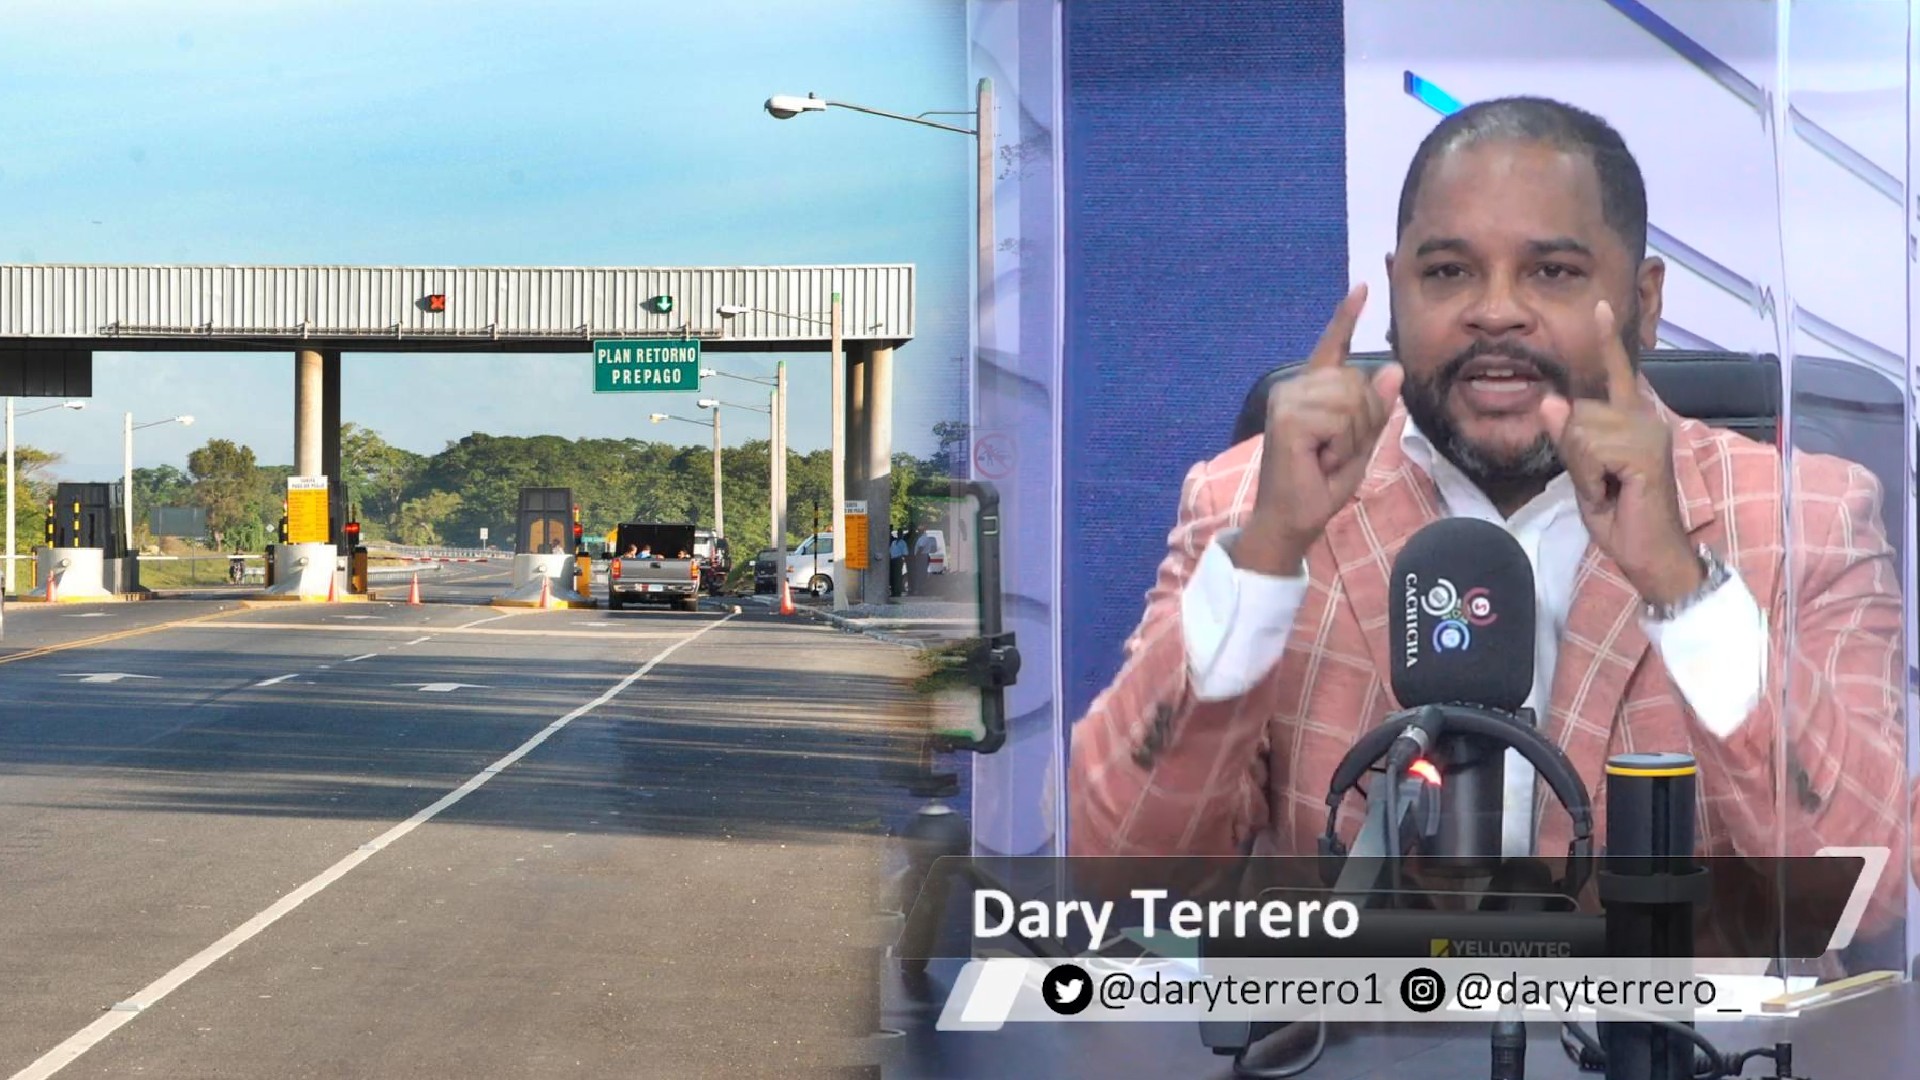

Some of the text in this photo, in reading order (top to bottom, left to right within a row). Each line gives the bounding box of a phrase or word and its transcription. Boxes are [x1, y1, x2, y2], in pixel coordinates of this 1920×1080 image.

[598, 347, 696, 363] PLAN RETORNO
[612, 368, 681, 384] PREPAGO
[1405, 573, 1419, 668] CACHICHA
[1452, 940, 1571, 957] YELLOWTEC
